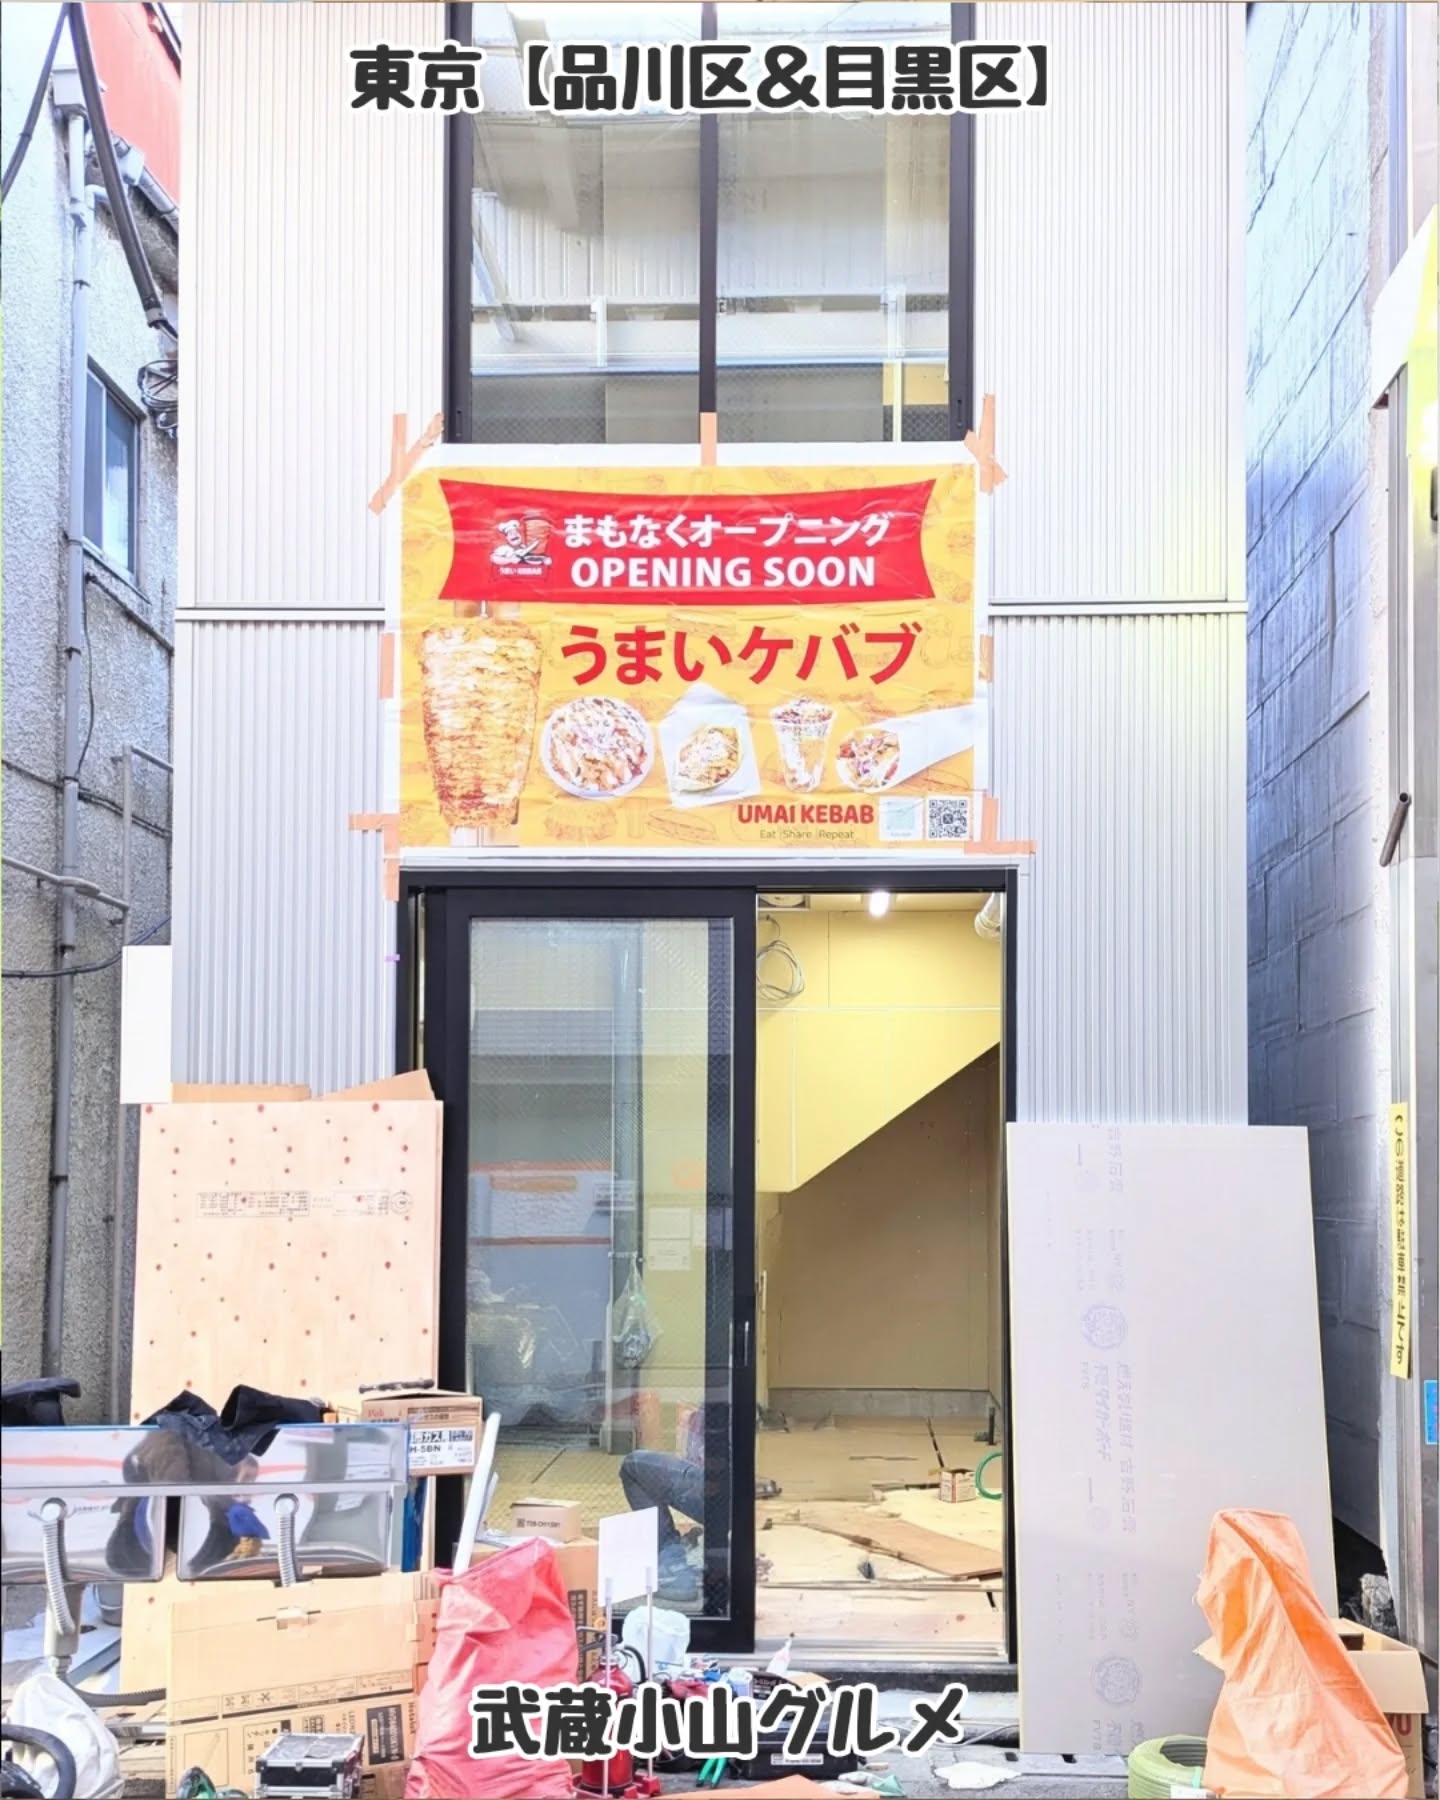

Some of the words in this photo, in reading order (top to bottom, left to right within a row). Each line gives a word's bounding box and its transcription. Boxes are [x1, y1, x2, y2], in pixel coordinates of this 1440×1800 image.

[563, 511, 894, 549] まもなくオープニング
[571, 557, 751, 588] OPENING
[764, 556, 875, 587] SOON
[560, 621, 922, 686] うまいケバブ
[738, 804, 795, 824] UMAI
[801, 804, 874, 824] KEBAB
[759, 829, 777, 839] Eat
[818, 829, 855, 841] Repeat
